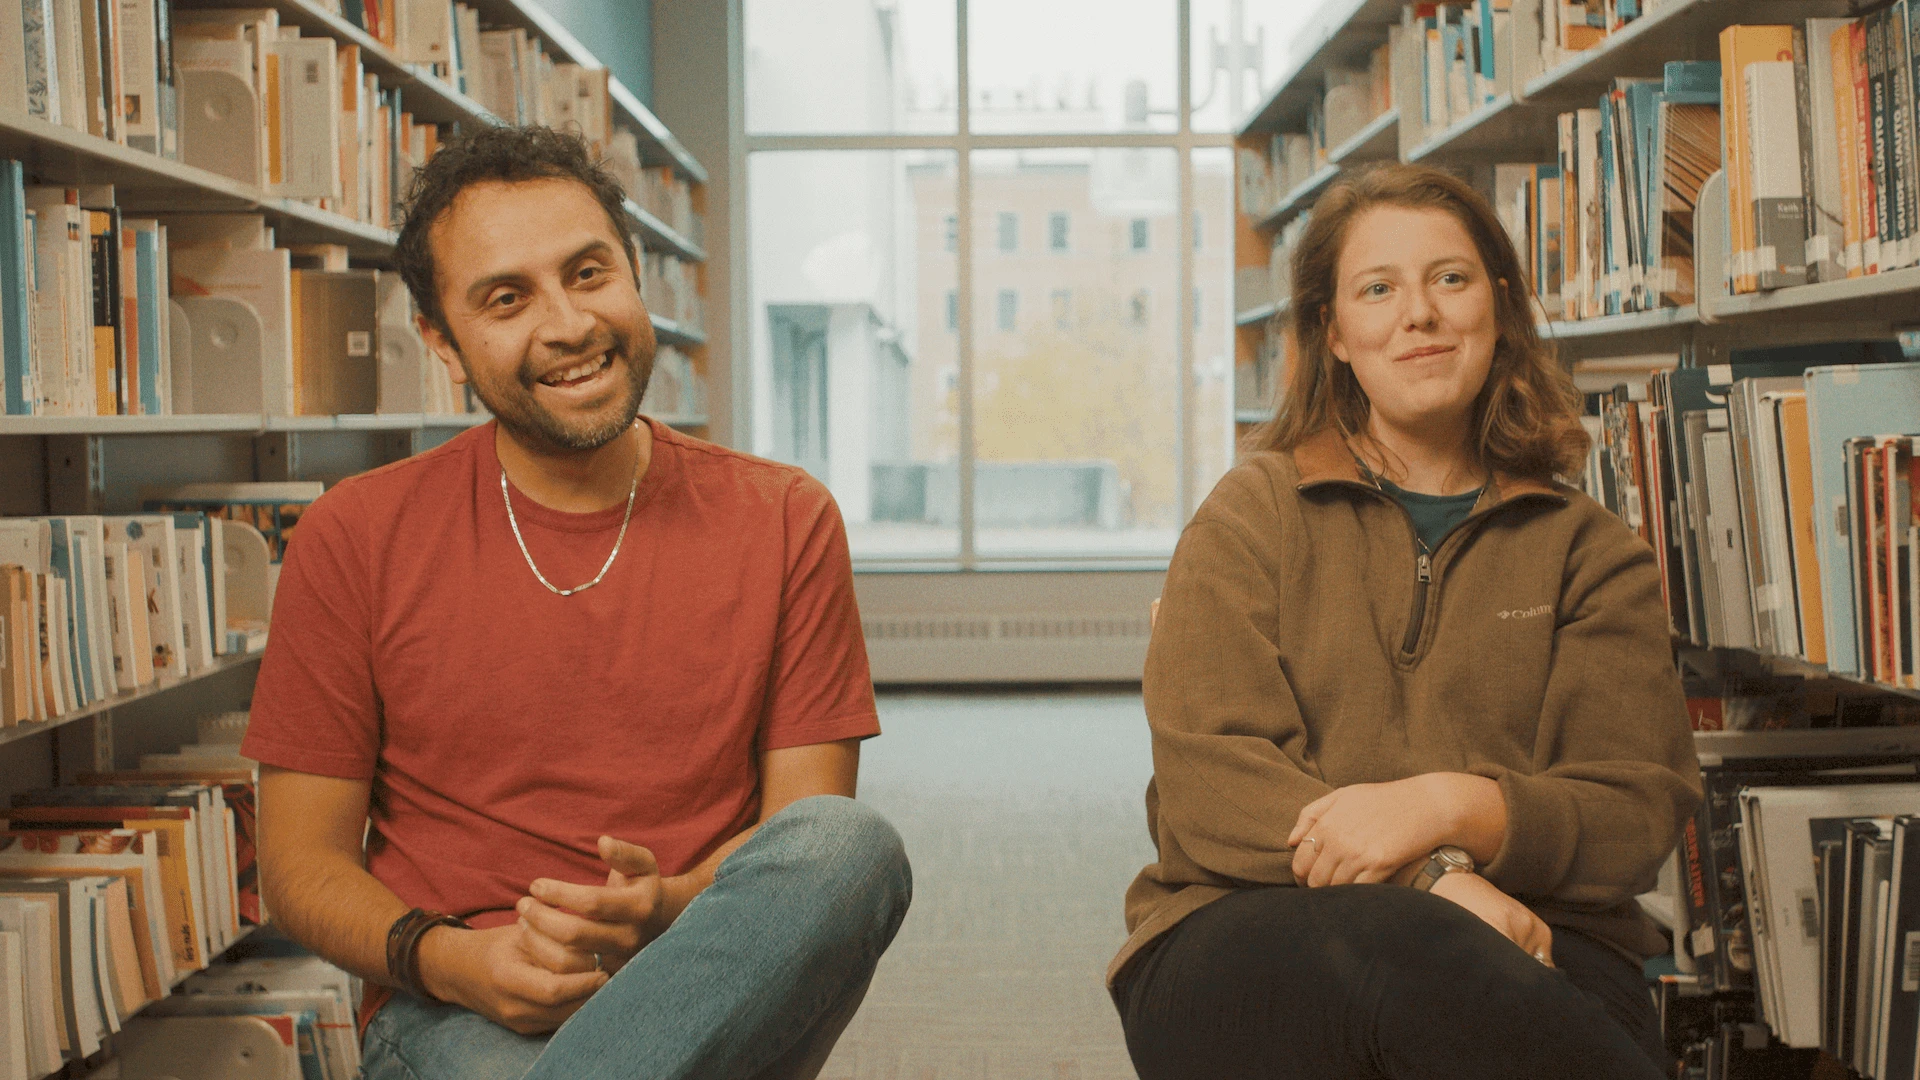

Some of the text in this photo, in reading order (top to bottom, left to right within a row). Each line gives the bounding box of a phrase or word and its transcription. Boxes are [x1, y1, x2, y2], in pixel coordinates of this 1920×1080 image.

[1874, 116, 1886, 173] L'AUTO
[1893, 109, 1904, 168] L'AUTO
[1878, 184, 1889, 235] GUIDE
[1896, 179, 1907, 231] GUIDE
